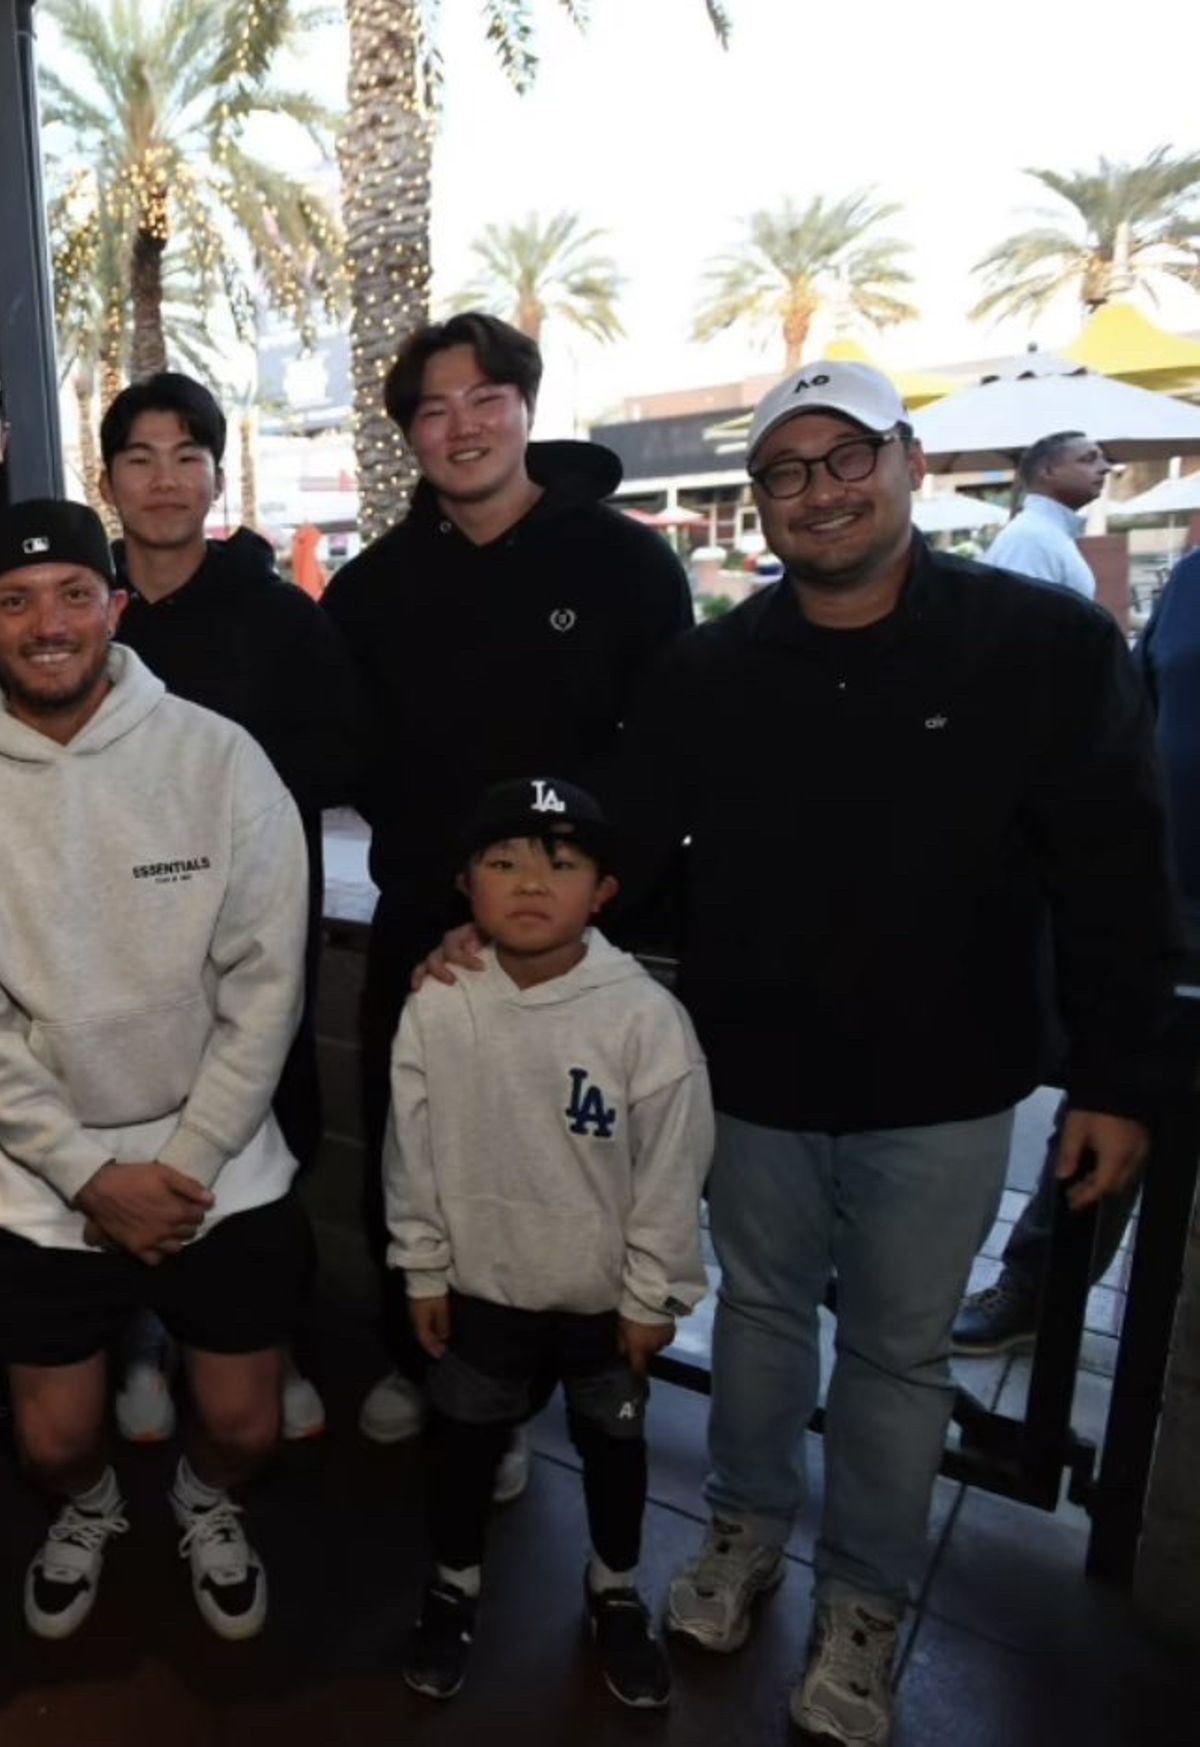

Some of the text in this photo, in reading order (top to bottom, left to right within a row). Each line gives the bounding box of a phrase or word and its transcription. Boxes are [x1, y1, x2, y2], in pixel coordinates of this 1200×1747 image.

[531, 781, 565, 811] LA
[132, 857, 210, 878] ESSENTIALS
[565, 1067, 616, 1137] LA
